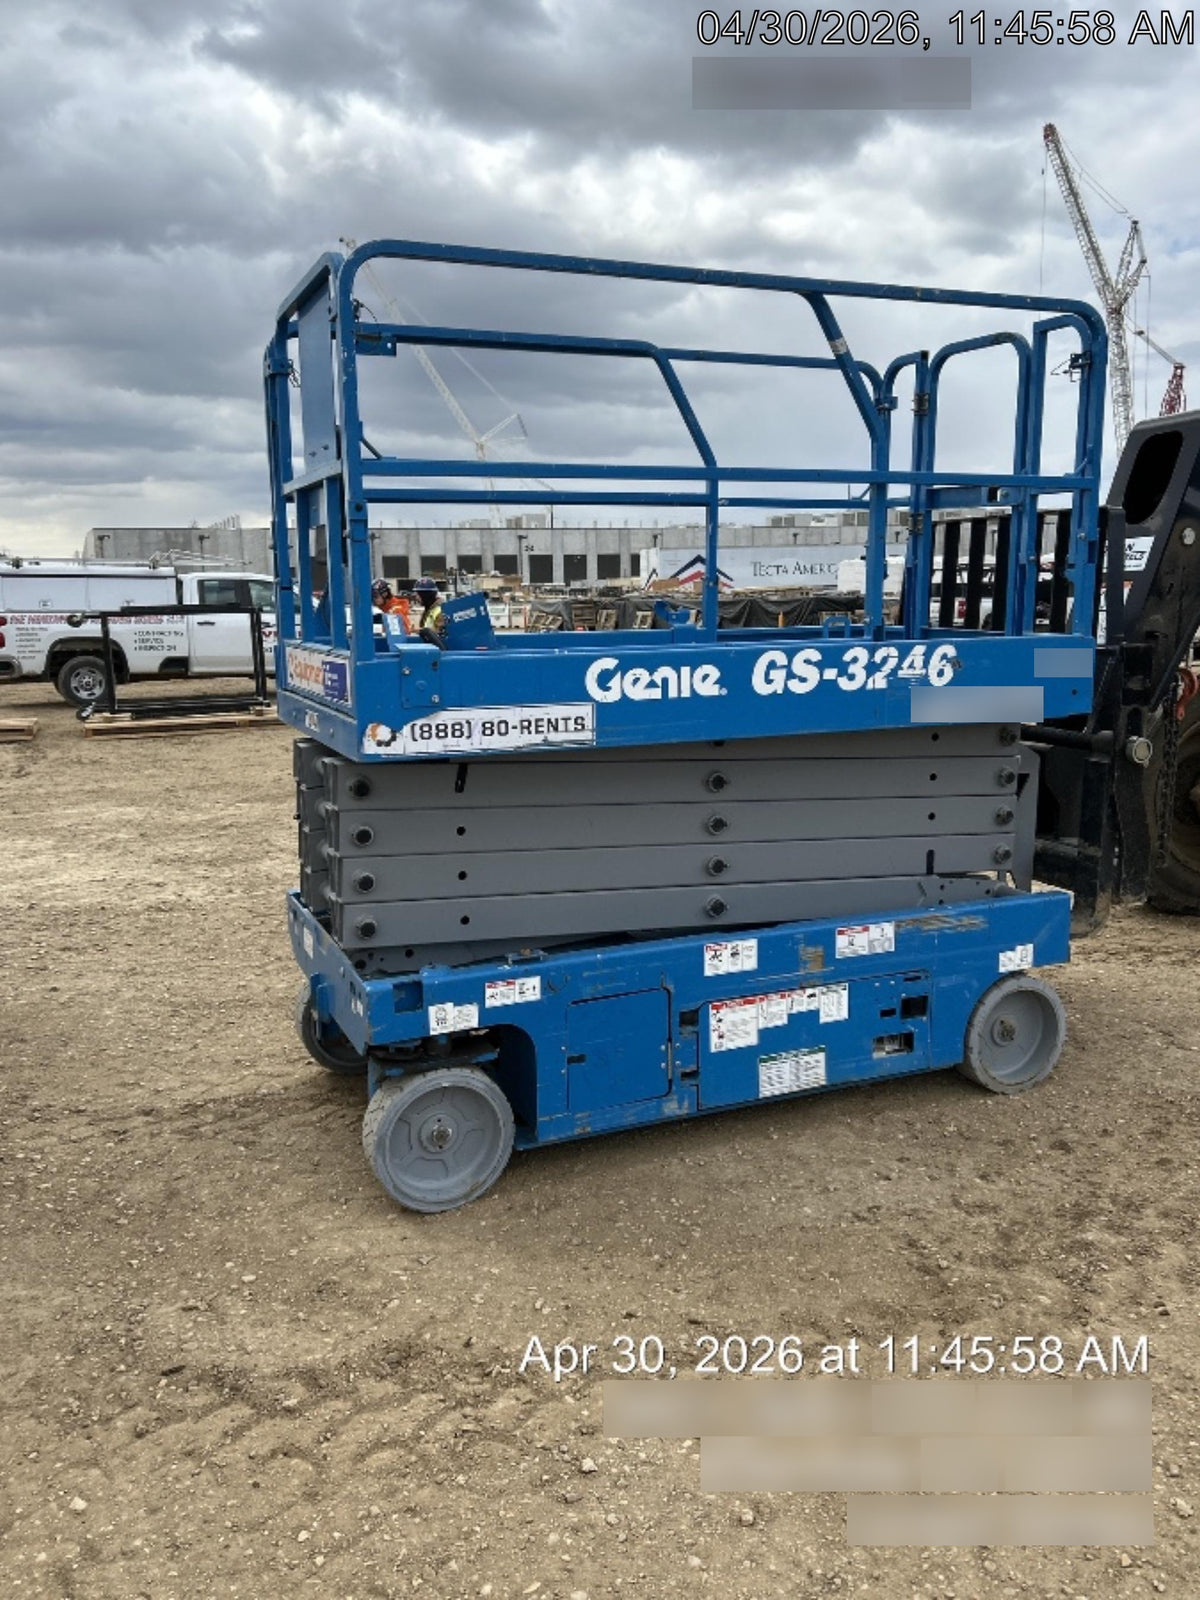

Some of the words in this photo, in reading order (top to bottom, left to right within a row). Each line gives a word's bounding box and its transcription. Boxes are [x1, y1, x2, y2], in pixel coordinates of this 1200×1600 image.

[585, 656, 721, 703] Genie
[752, 644, 957, 696] GS-3246
[410, 722, 472, 741] (888)
[481, 716, 586, 737] 80-RENTS
